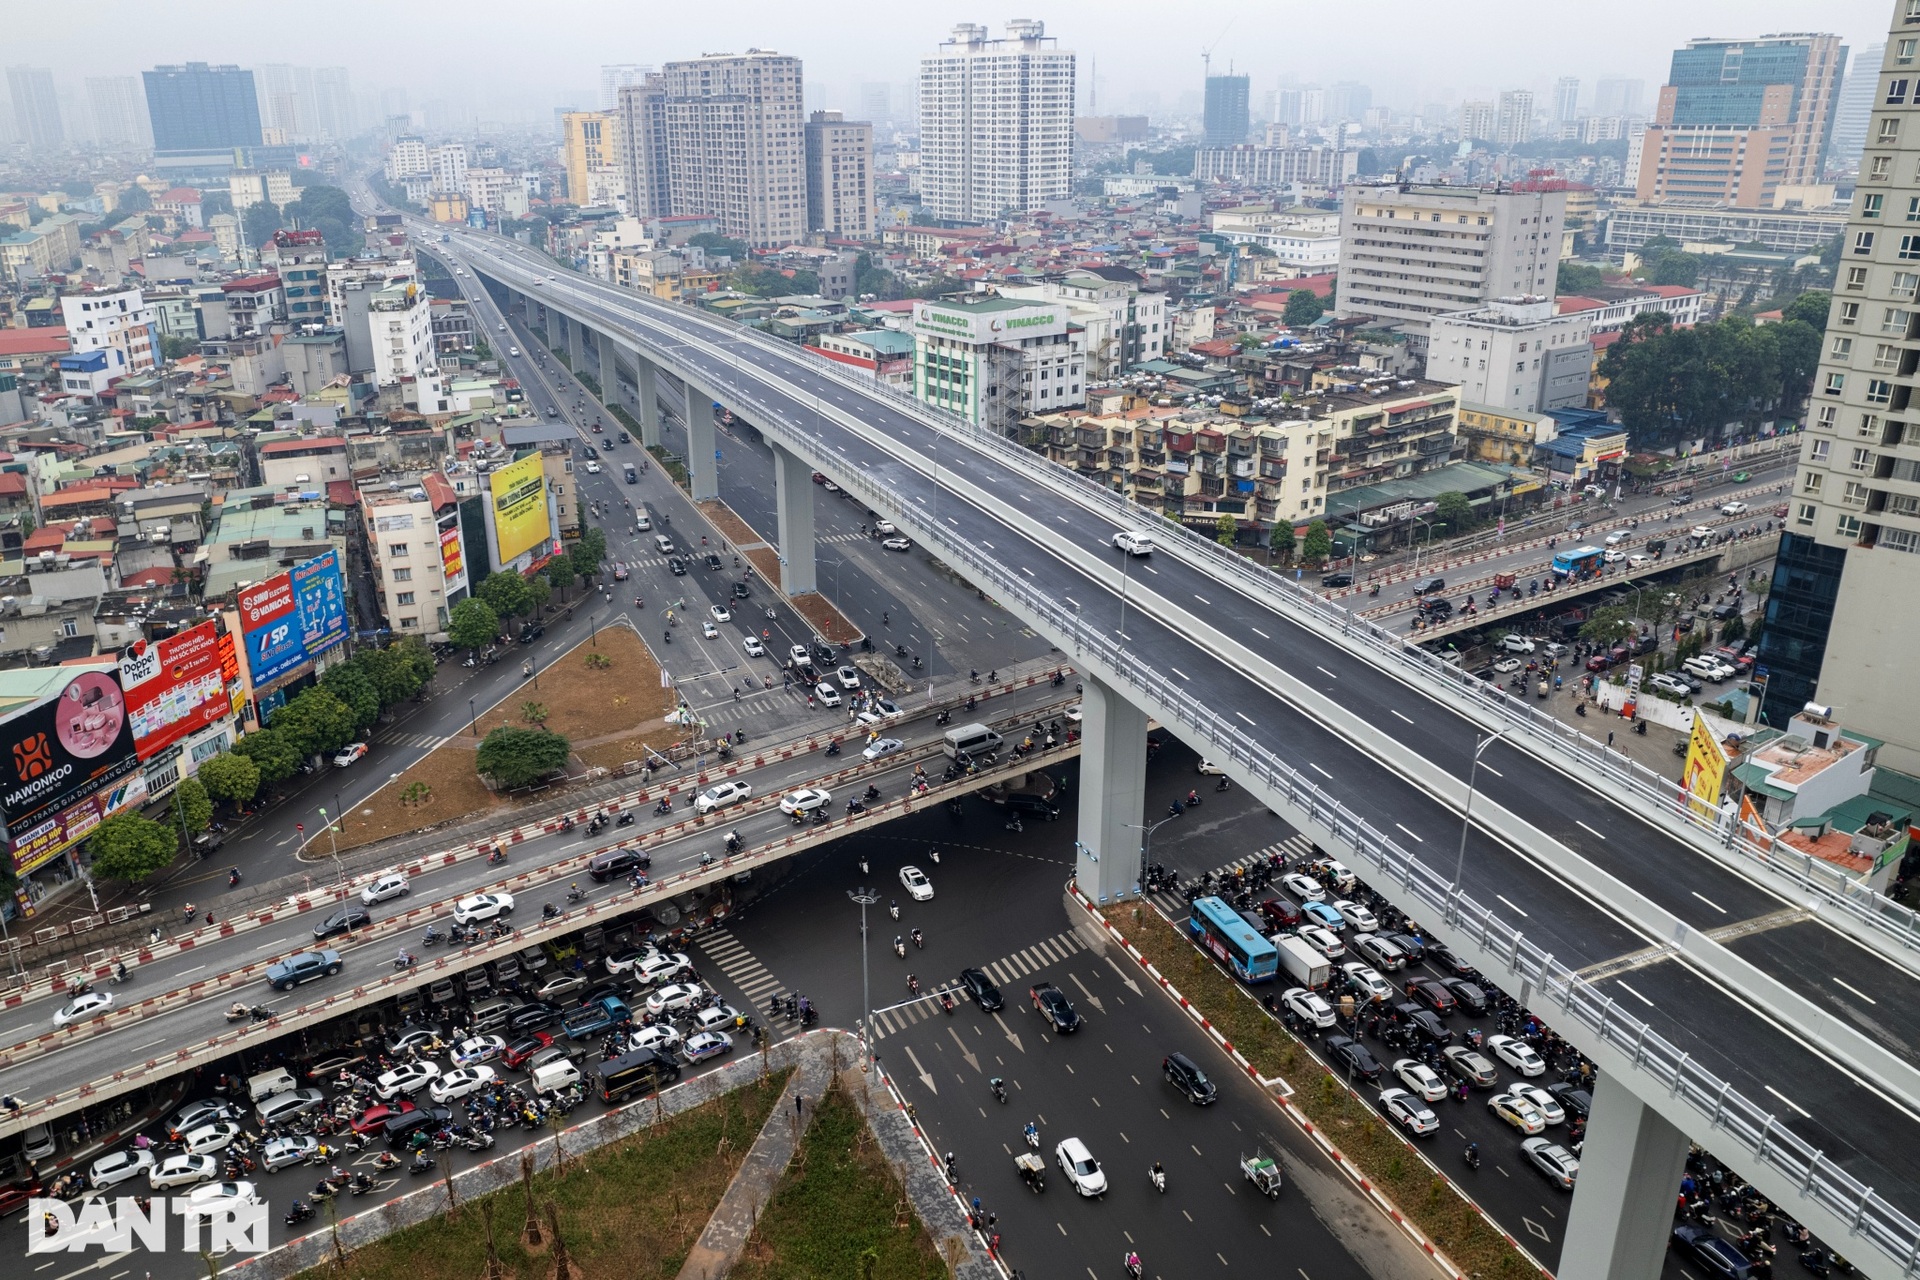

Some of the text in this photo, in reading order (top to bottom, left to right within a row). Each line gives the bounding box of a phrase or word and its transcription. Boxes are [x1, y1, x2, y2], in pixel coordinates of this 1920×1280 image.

[932, 313, 968, 328] VINACCO
[1006, 314, 1054, 328] VINACCO
[252, 590, 268, 606] SINO
[269, 584, 290, 598] ELECTRIC
[260, 594, 292, 616] VANLOCK
[271, 624, 288, 645] SP
[168, 640, 192, 656] THƯƠNG
[178, 650, 188, 660] SÓC
[124, 652, 155, 675] Doppel
[132, 668, 152, 682] herz
[5, 764, 72, 807] HAWONKOO
[33, 804, 60, 820] TRANG
[62, 794, 76, 806] GIA
[18, 830, 40, 846] THANH
[12, 844, 32, 860] THÉP
